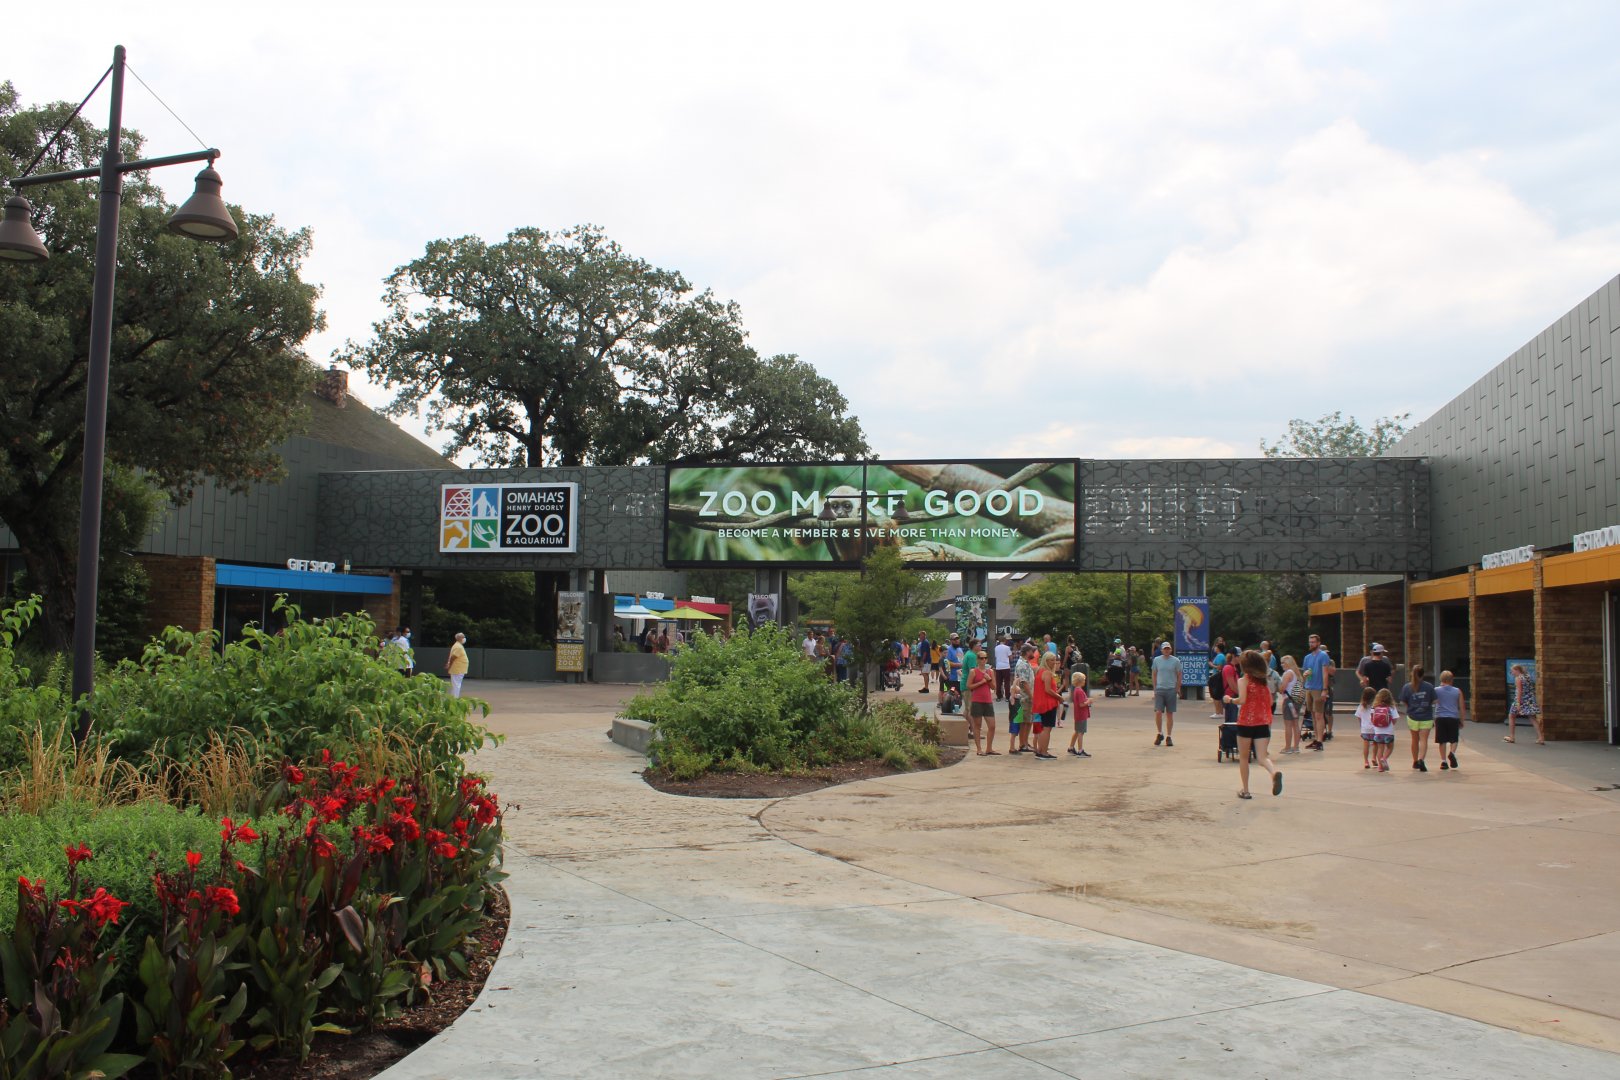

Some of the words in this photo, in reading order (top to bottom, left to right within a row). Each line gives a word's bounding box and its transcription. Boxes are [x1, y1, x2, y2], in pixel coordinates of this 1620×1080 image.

[507, 491, 565, 503] OMAHA'S
[699, 490, 776, 517] ZOO
[791, 489, 908, 517] MRE
[924, 489, 1045, 517] GOOD
[506, 514, 564, 536] ZOO
[718, 528, 769, 538] BECOME
[772, 529, 780, 538] A
[783, 528, 838, 538] MEMBER
[841, 528, 850, 538] &
[889, 528, 927, 538] MORE
[931, 528, 967, 538] THAN
[970, 528, 1019, 538] MONEY.
[506, 537, 512, 545] &
[513, 536, 563, 545] AQUARIUM
[287, 558, 310, 571] GIFT
[310, 560, 335, 573] SHOP
